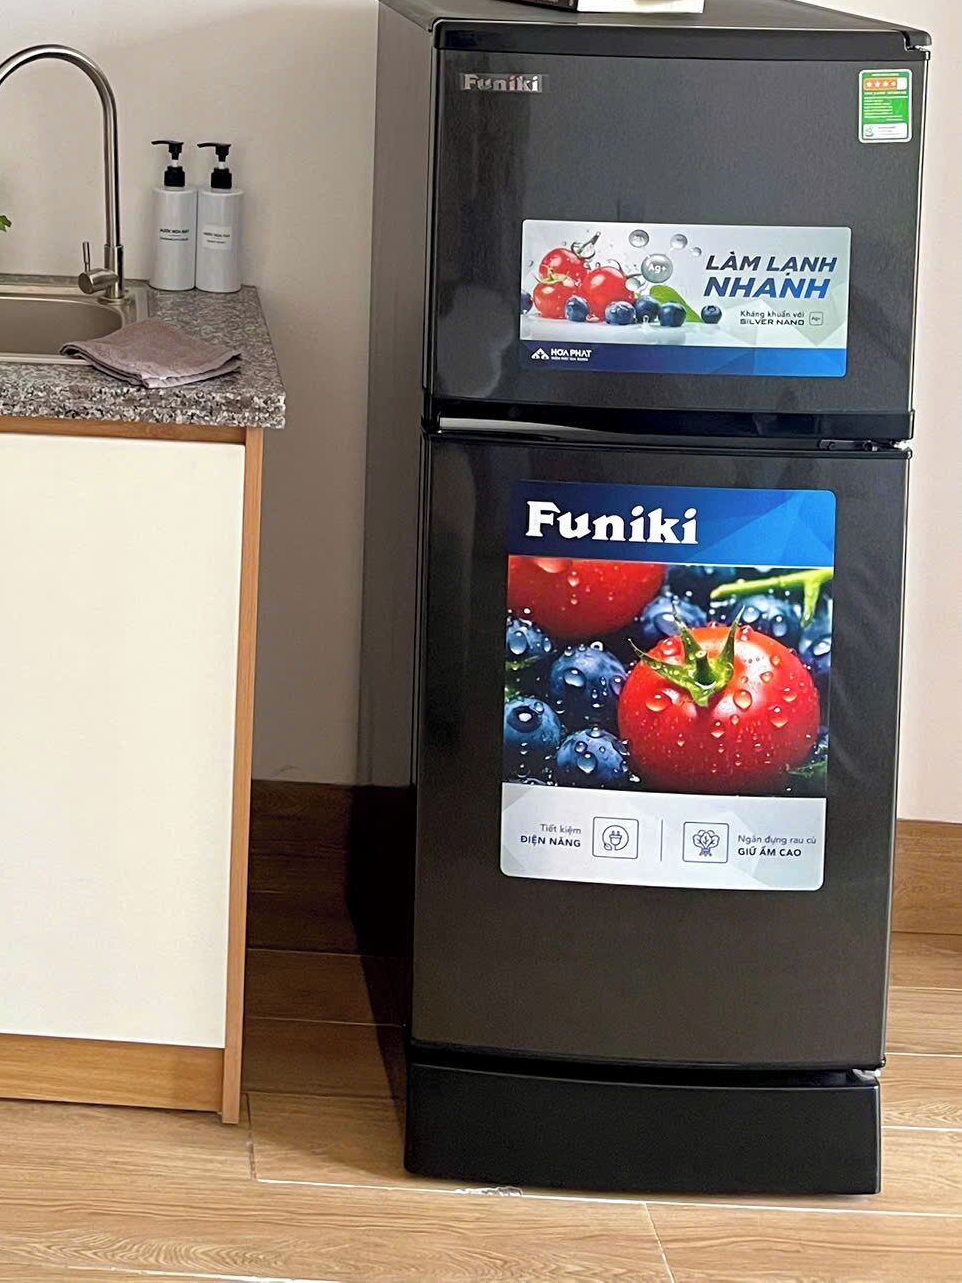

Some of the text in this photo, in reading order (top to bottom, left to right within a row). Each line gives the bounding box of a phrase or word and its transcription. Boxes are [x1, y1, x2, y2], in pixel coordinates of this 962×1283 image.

[463, 73, 538, 92] Funiki
[648, 264, 667, 274] Ag+
[705, 251, 838, 276] LÀM LẠNH
[703, 277, 831, 299] NHANH
[740, 310, 765, 318] Kháng
[525, 500, 699, 545] Funiki
[540, 824, 582, 835] Tiết kiệm
[520, 834, 581, 848] ĐIỆN NĂNG
[779, 849, 802, 857] CAO
